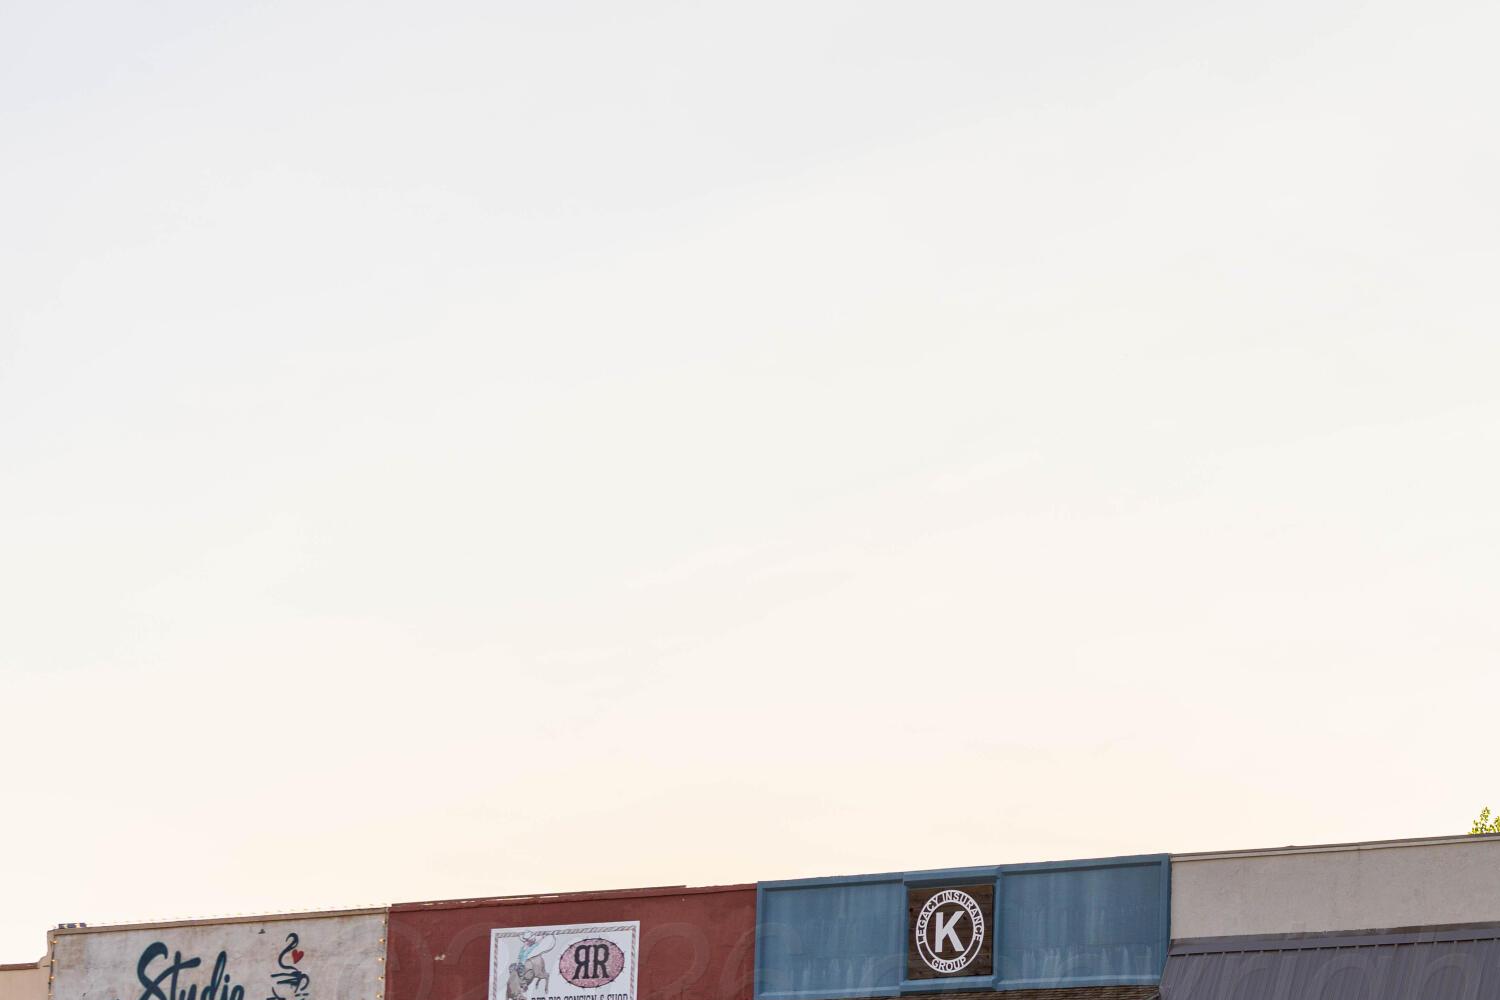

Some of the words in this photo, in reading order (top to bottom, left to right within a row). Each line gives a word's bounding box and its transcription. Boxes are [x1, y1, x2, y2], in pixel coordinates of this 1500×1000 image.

[917, 896, 939, 945] LEGACY
[942, 891, 983, 942] INSURANCE
[934, 910, 966, 953] K
[931, 956, 967, 971] GROUP
